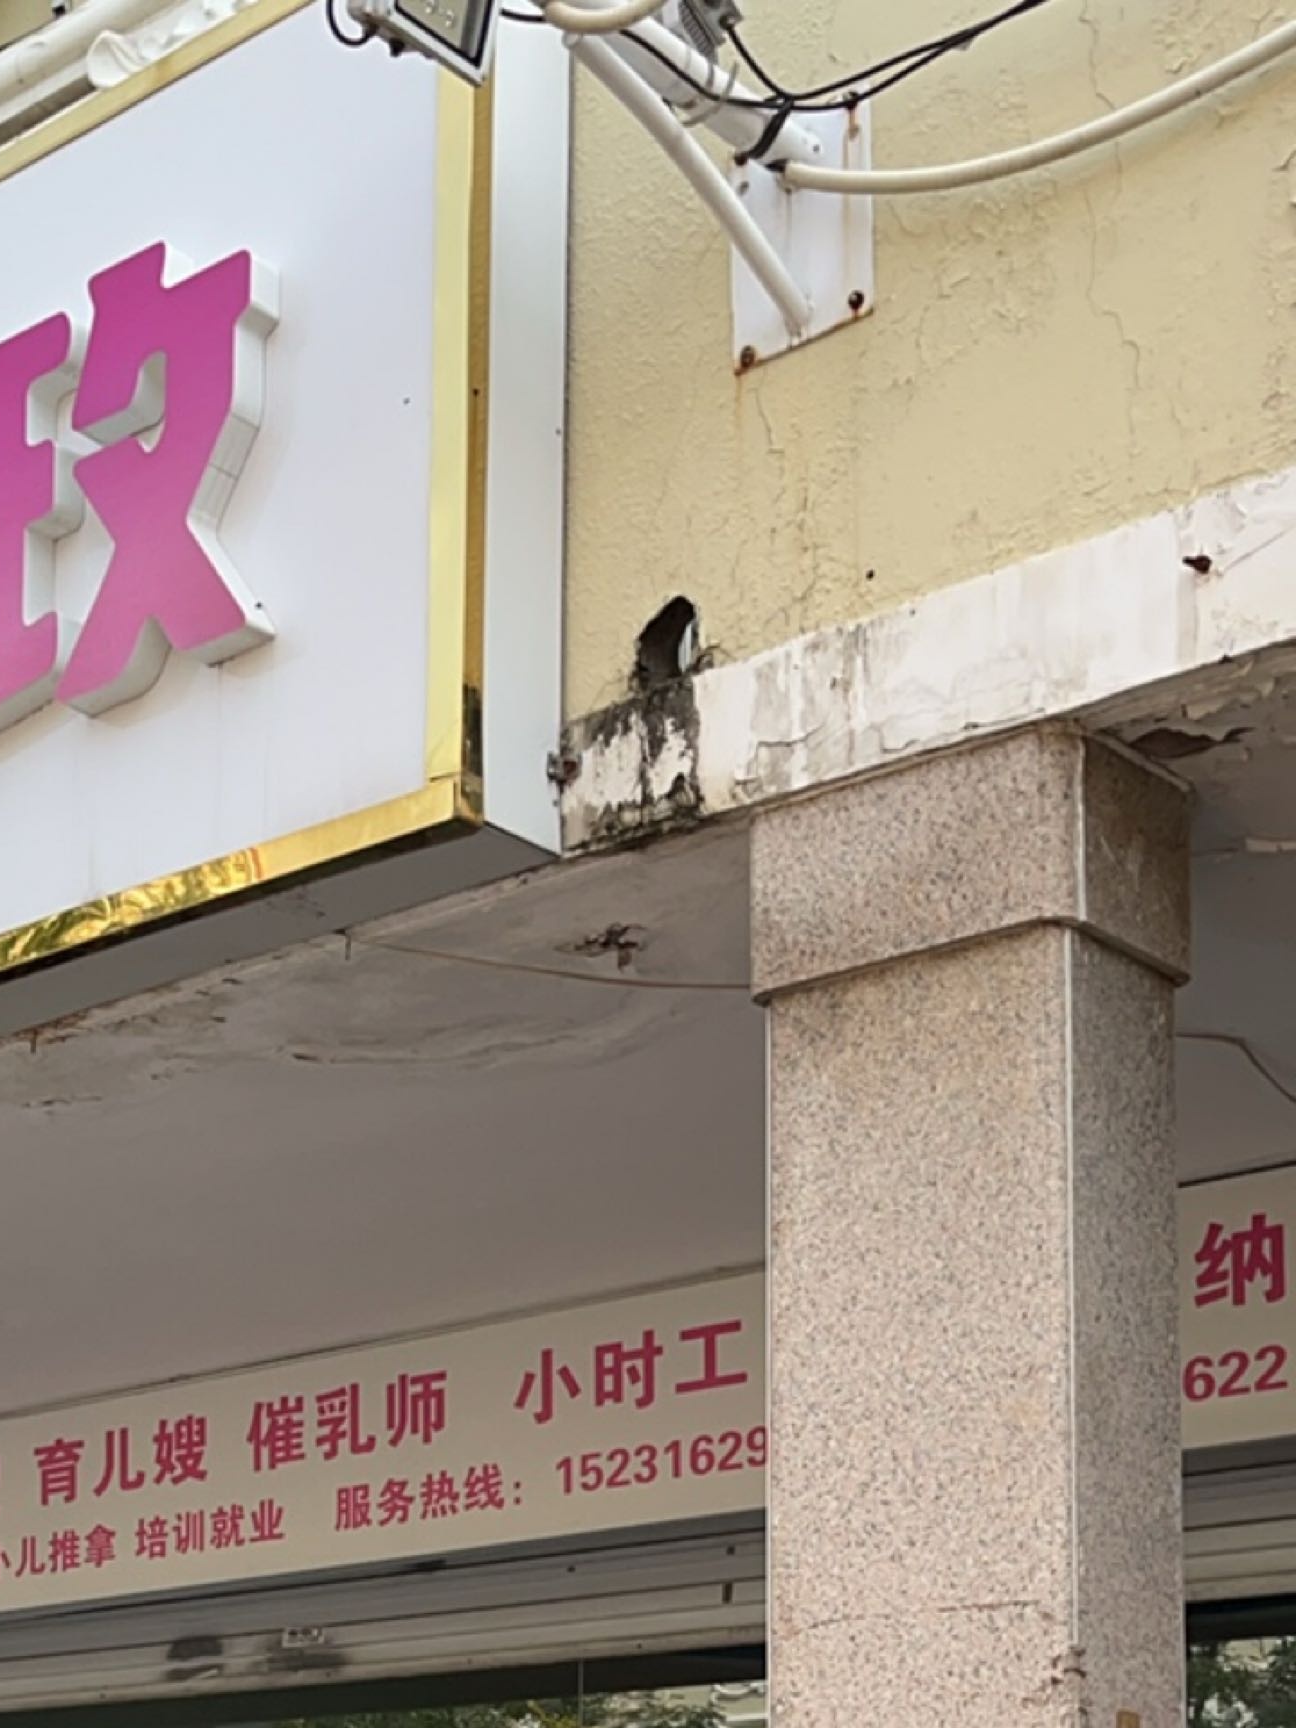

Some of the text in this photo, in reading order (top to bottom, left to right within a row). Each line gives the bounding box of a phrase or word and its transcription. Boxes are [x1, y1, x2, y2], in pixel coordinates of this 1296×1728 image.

[1194, 1212, 1286, 1307] 纳
[34, 1415, 208, 1505] 育儿嫂
[246, 1371, 447, 1473] 催乳师
[515, 1319, 748, 1425] 小时工
[1182, 1344, 1288, 1402] 622
[135, 1499, 285, 1559] 培训就业
[555, 1425, 767, 1495] 15231629
